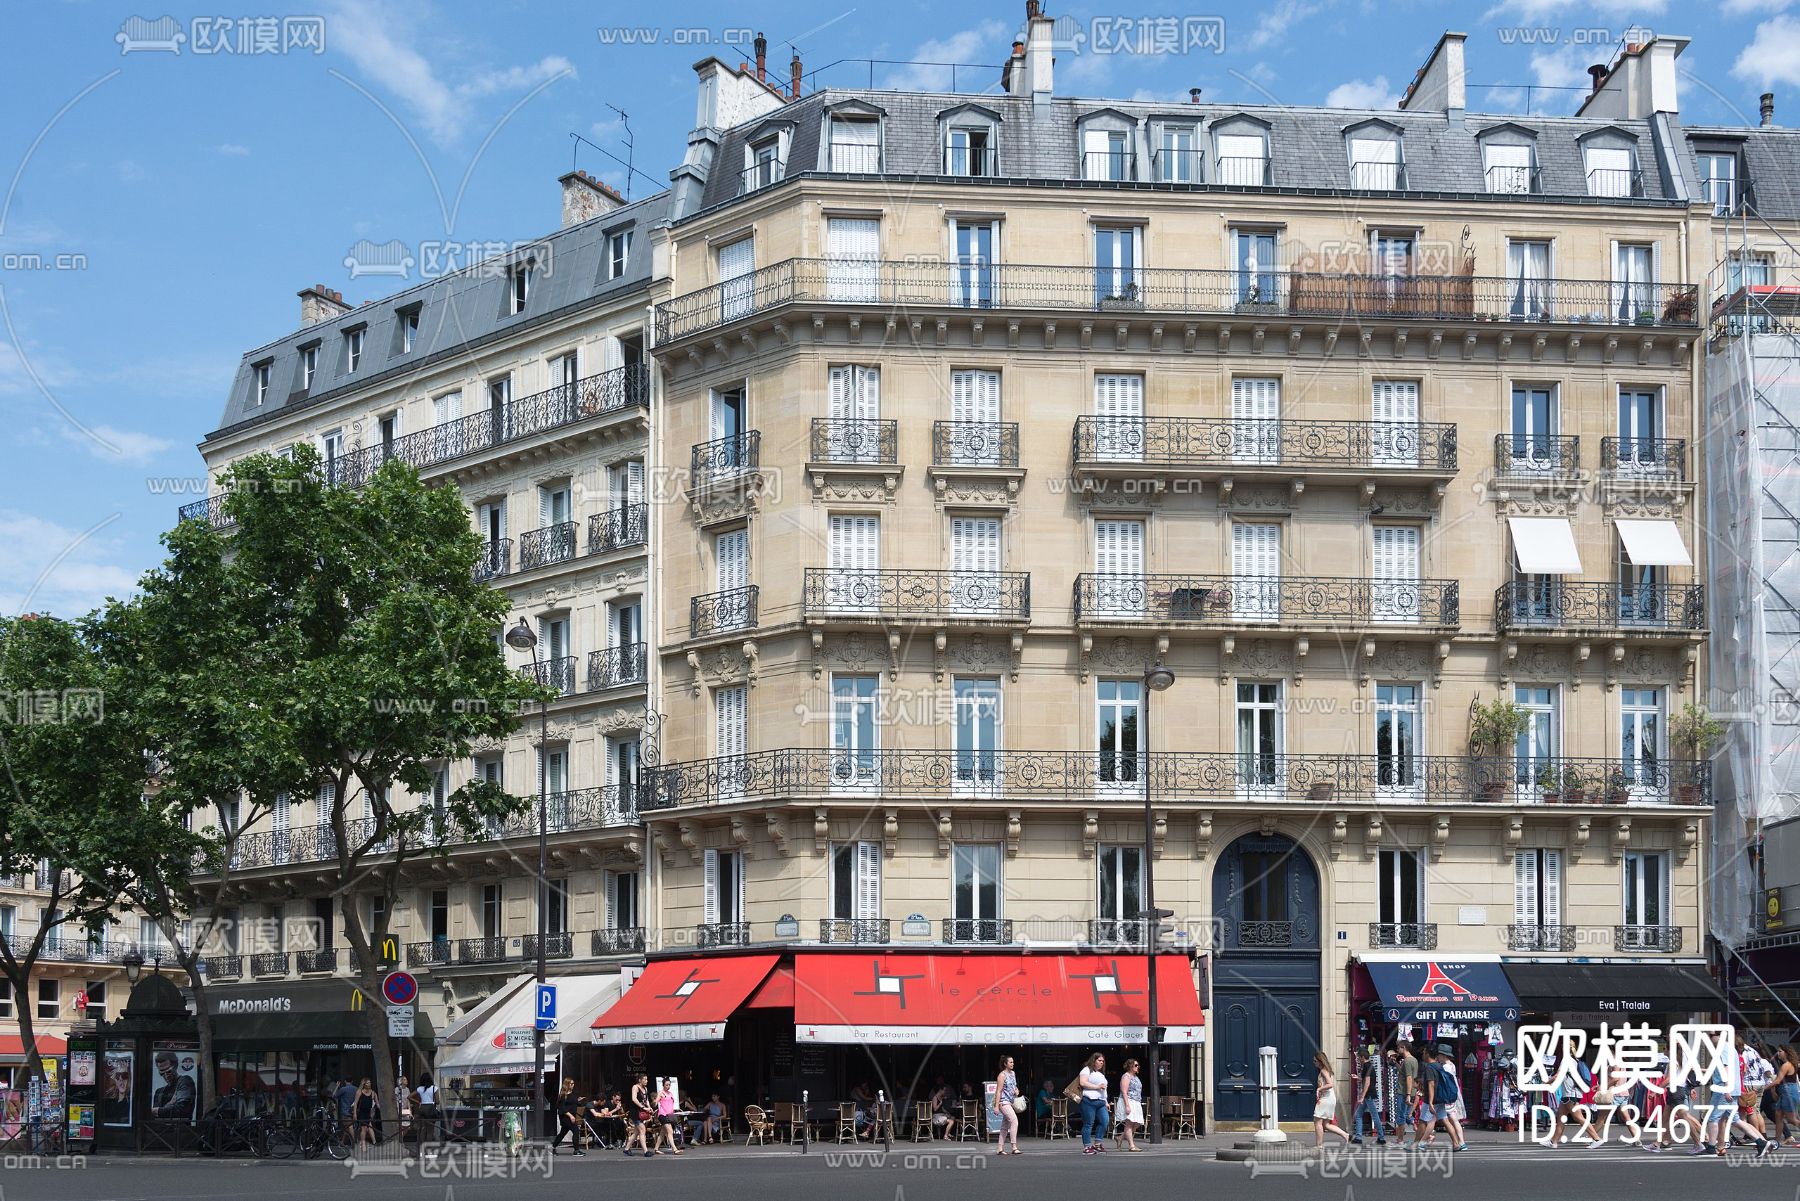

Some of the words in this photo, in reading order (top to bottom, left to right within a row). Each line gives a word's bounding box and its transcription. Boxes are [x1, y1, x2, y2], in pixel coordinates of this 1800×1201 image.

[219, 997, 292, 1014] McDonald's
[1599, 1001, 1615, 1010] Eva
[1621, 1001, 1651, 1010] Tralala
[1416, 1010, 1438, 1020] GIFT
[1443, 1010, 1490, 1020] PARADISE
[854, 1030, 869, 1039] Bar
[874, 1029, 919, 1039] Restaurant
[1114, 1030, 1144, 1039] Glaces
